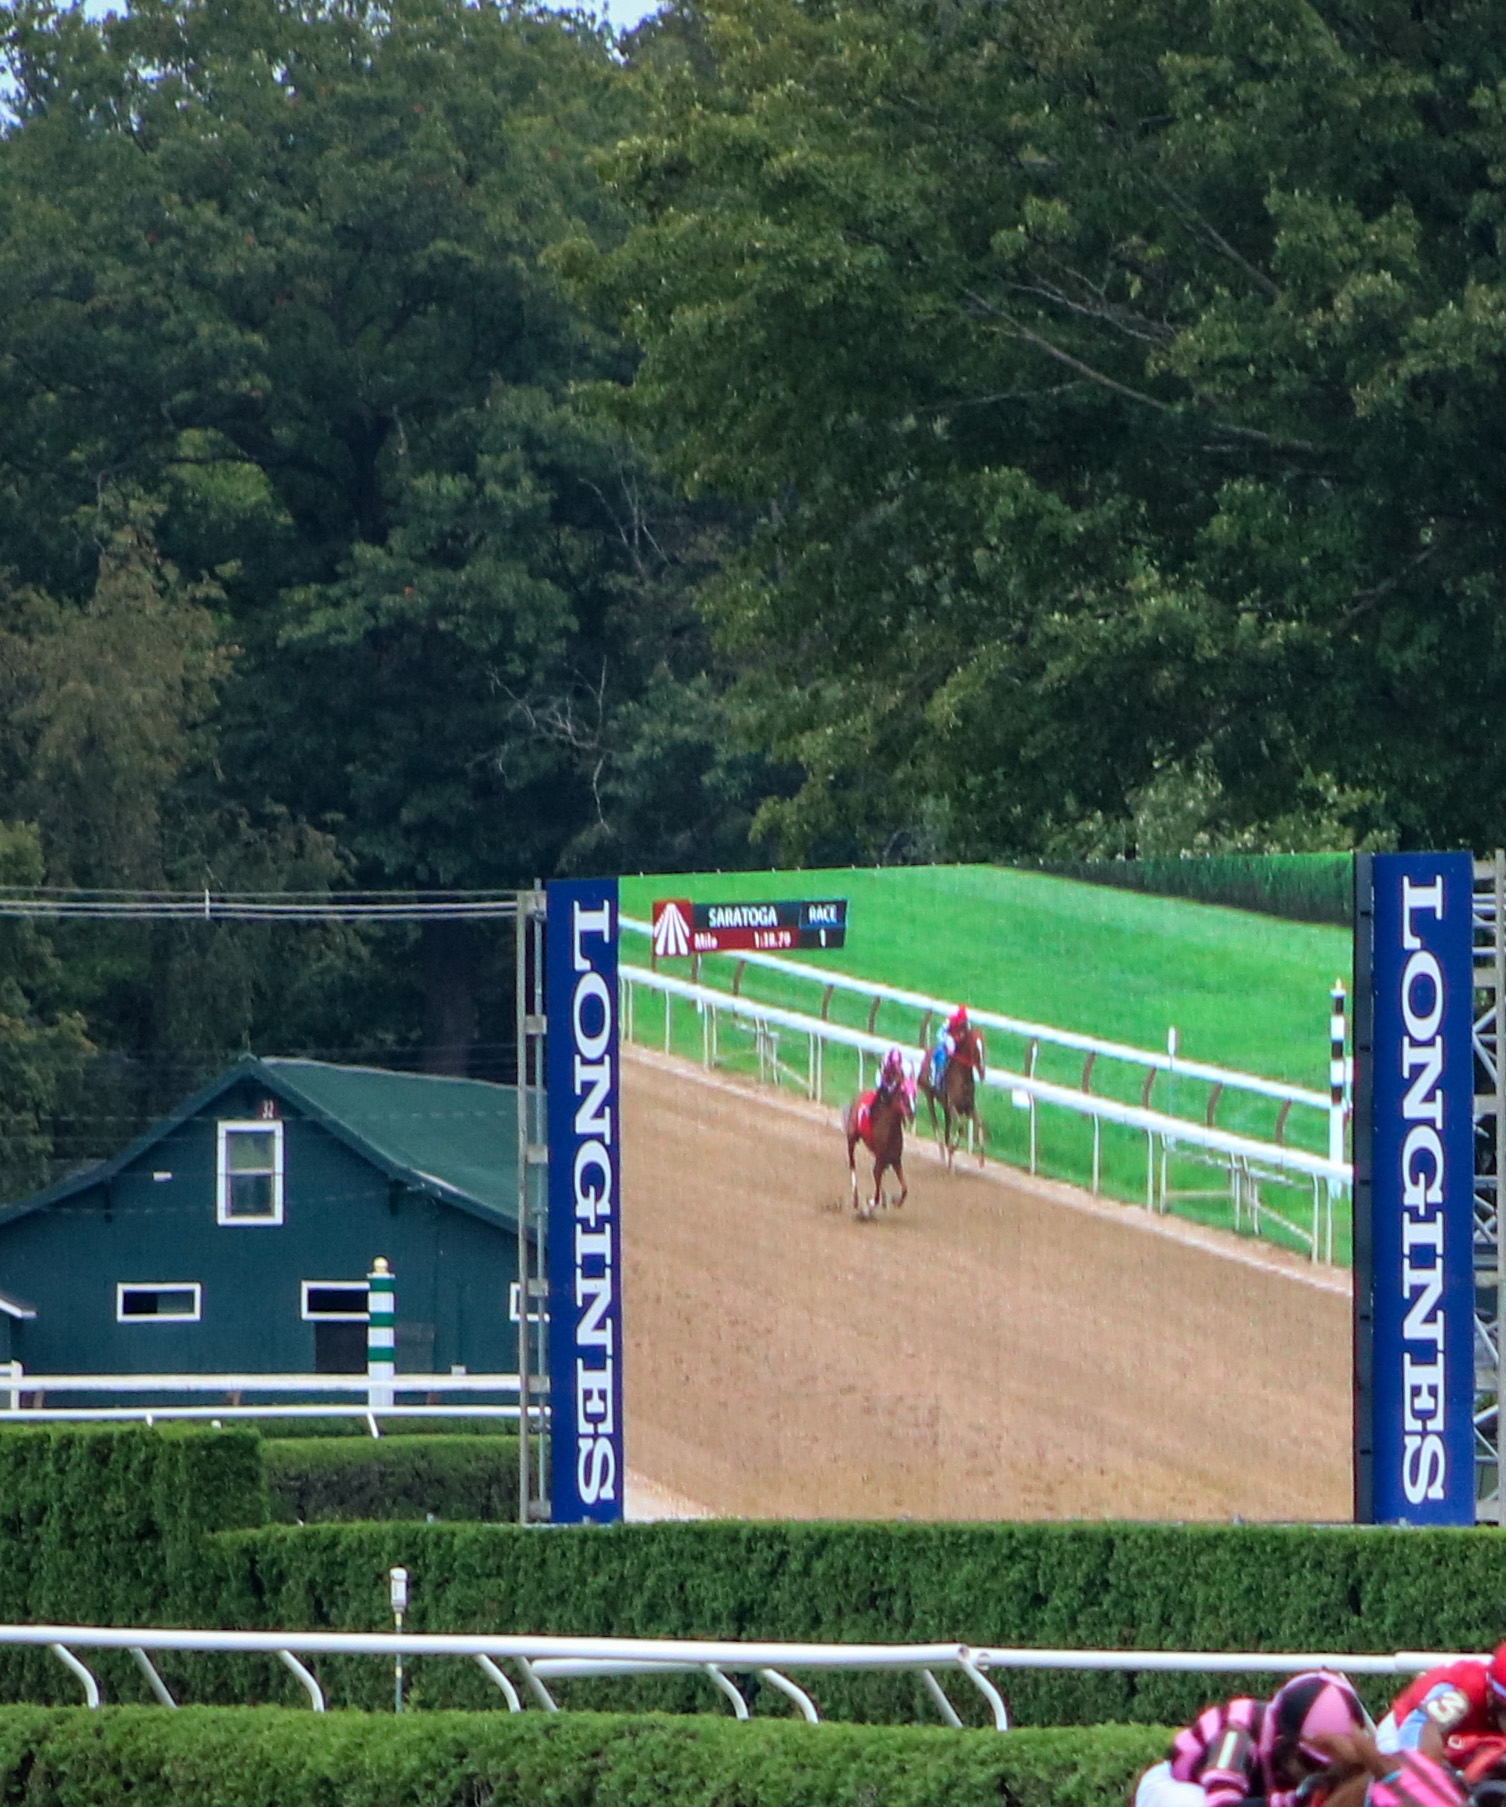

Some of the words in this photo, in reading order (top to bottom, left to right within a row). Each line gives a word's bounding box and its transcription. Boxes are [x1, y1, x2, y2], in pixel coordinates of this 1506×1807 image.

[708, 905, 778, 928] SARATOGA
[808, 904, 838, 925] RACE
[572, 899, 617, 1506] LONGINES
[1401, 874, 1446, 1506] LONGINES
